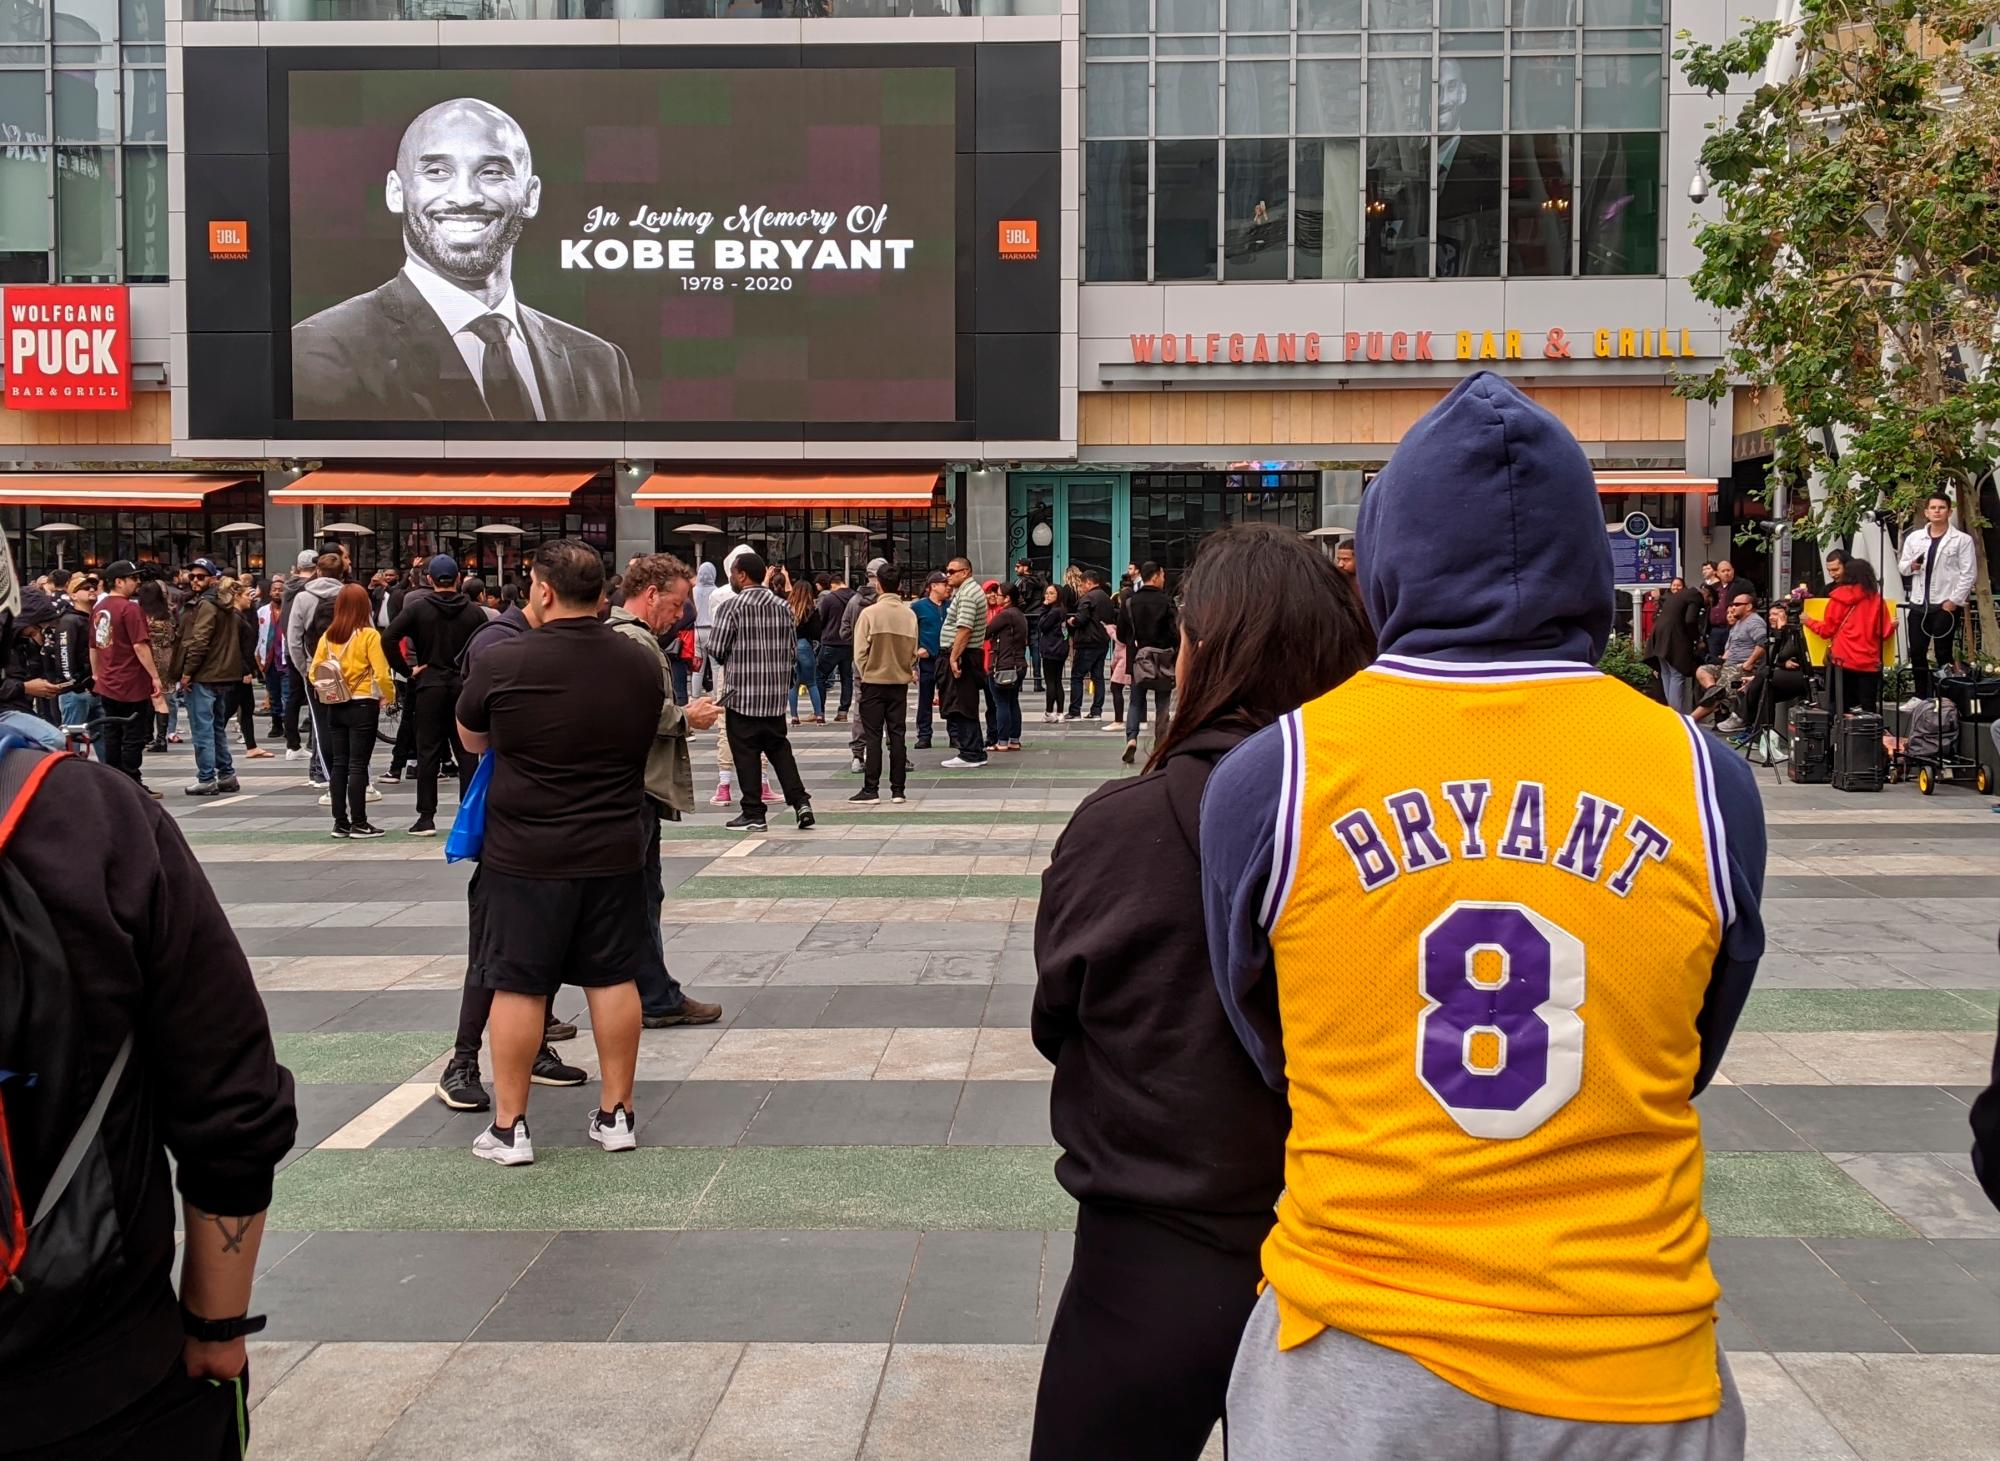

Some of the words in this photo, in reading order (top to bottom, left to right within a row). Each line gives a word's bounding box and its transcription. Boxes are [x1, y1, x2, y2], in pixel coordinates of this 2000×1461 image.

[583, 205, 620, 233] In
[628, 204, 714, 235] Loving
[723, 204, 838, 238] Memory
[846, 203, 888, 234] Of
[216, 229, 241, 244] JBL
[1006, 229, 1031, 244] JBL
[560, 239, 696, 270] KOBE
[714, 239, 914, 270] BRYANT
[680, 276, 725, 291] 1978
[744, 276, 793, 291] 2020
[11, 305, 115, 322] WOLFGANG
[12, 328, 119, 375] PUCK
[1130, 332, 1321, 364] WOLFGANG
[1345, 331, 1432, 362] PUCK
[1456, 329, 1523, 360] BAR
[1543, 327, 1571, 358] &
[1593, 327, 1695, 359] GRILL
[12, 387, 44, 396] BAR
[49, 387, 58, 396] &
[63, 387, 118, 396] GRILL
[59, 630, 68, 646] THE
[1331, 779, 1672, 897] BRYANT
[1416, 900, 1585, 1139] 8
